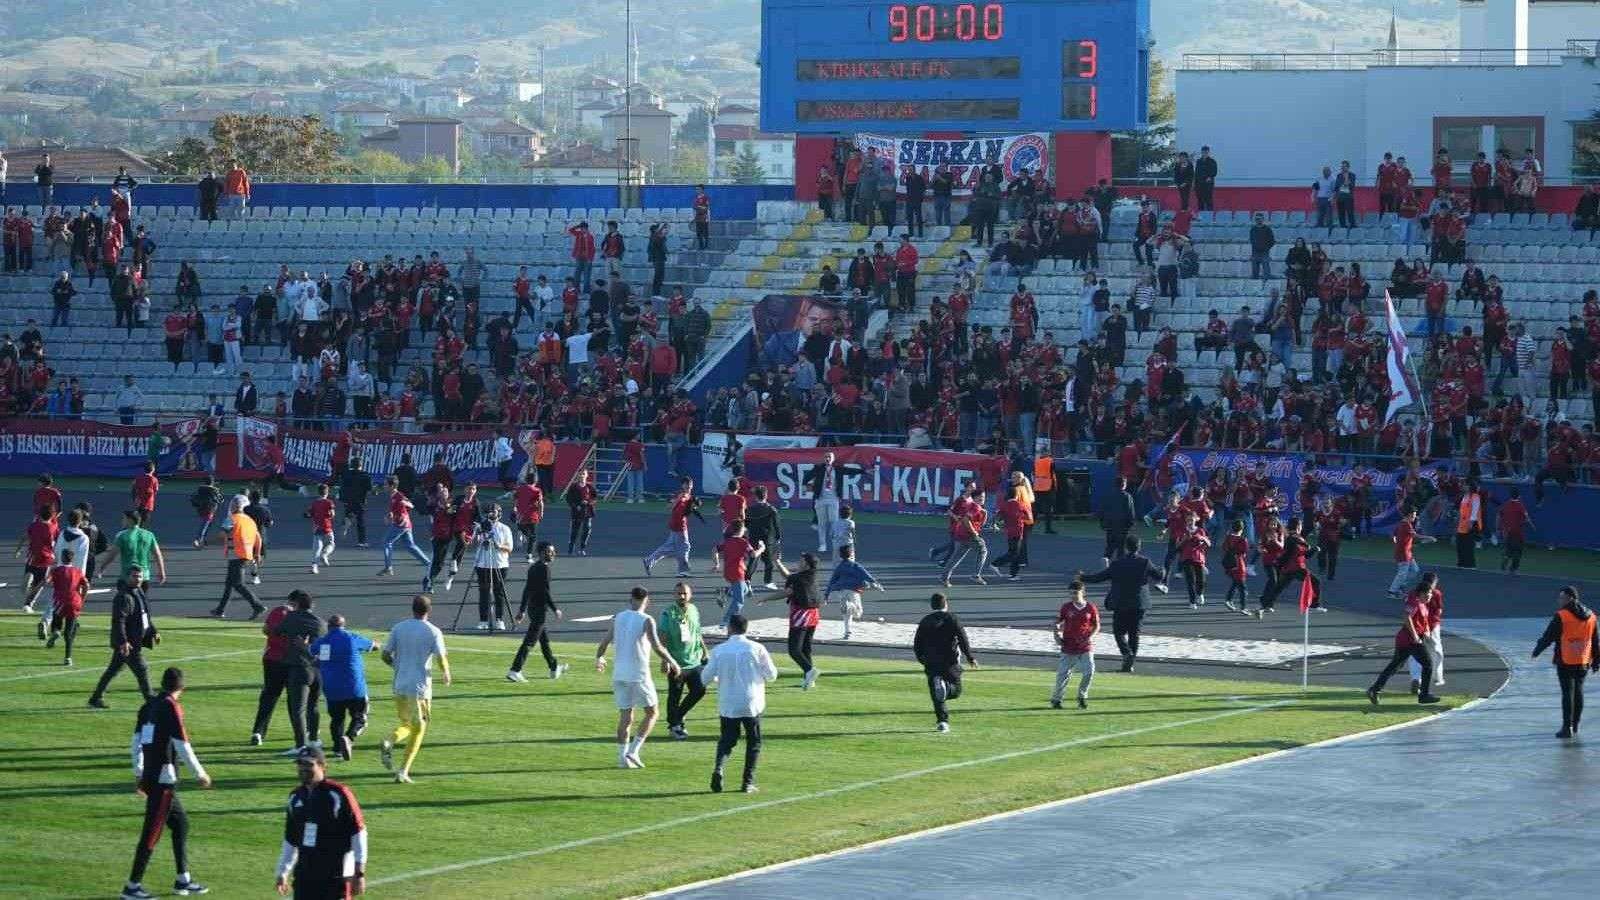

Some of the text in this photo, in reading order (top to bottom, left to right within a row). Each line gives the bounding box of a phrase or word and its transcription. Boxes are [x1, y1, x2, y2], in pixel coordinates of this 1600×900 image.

[889, 4, 1004, 42] 90:00
[1079, 40, 1097, 78] 3
[1090, 85, 1096, 119] 1
[901, 139, 1004, 165] SERKAN
